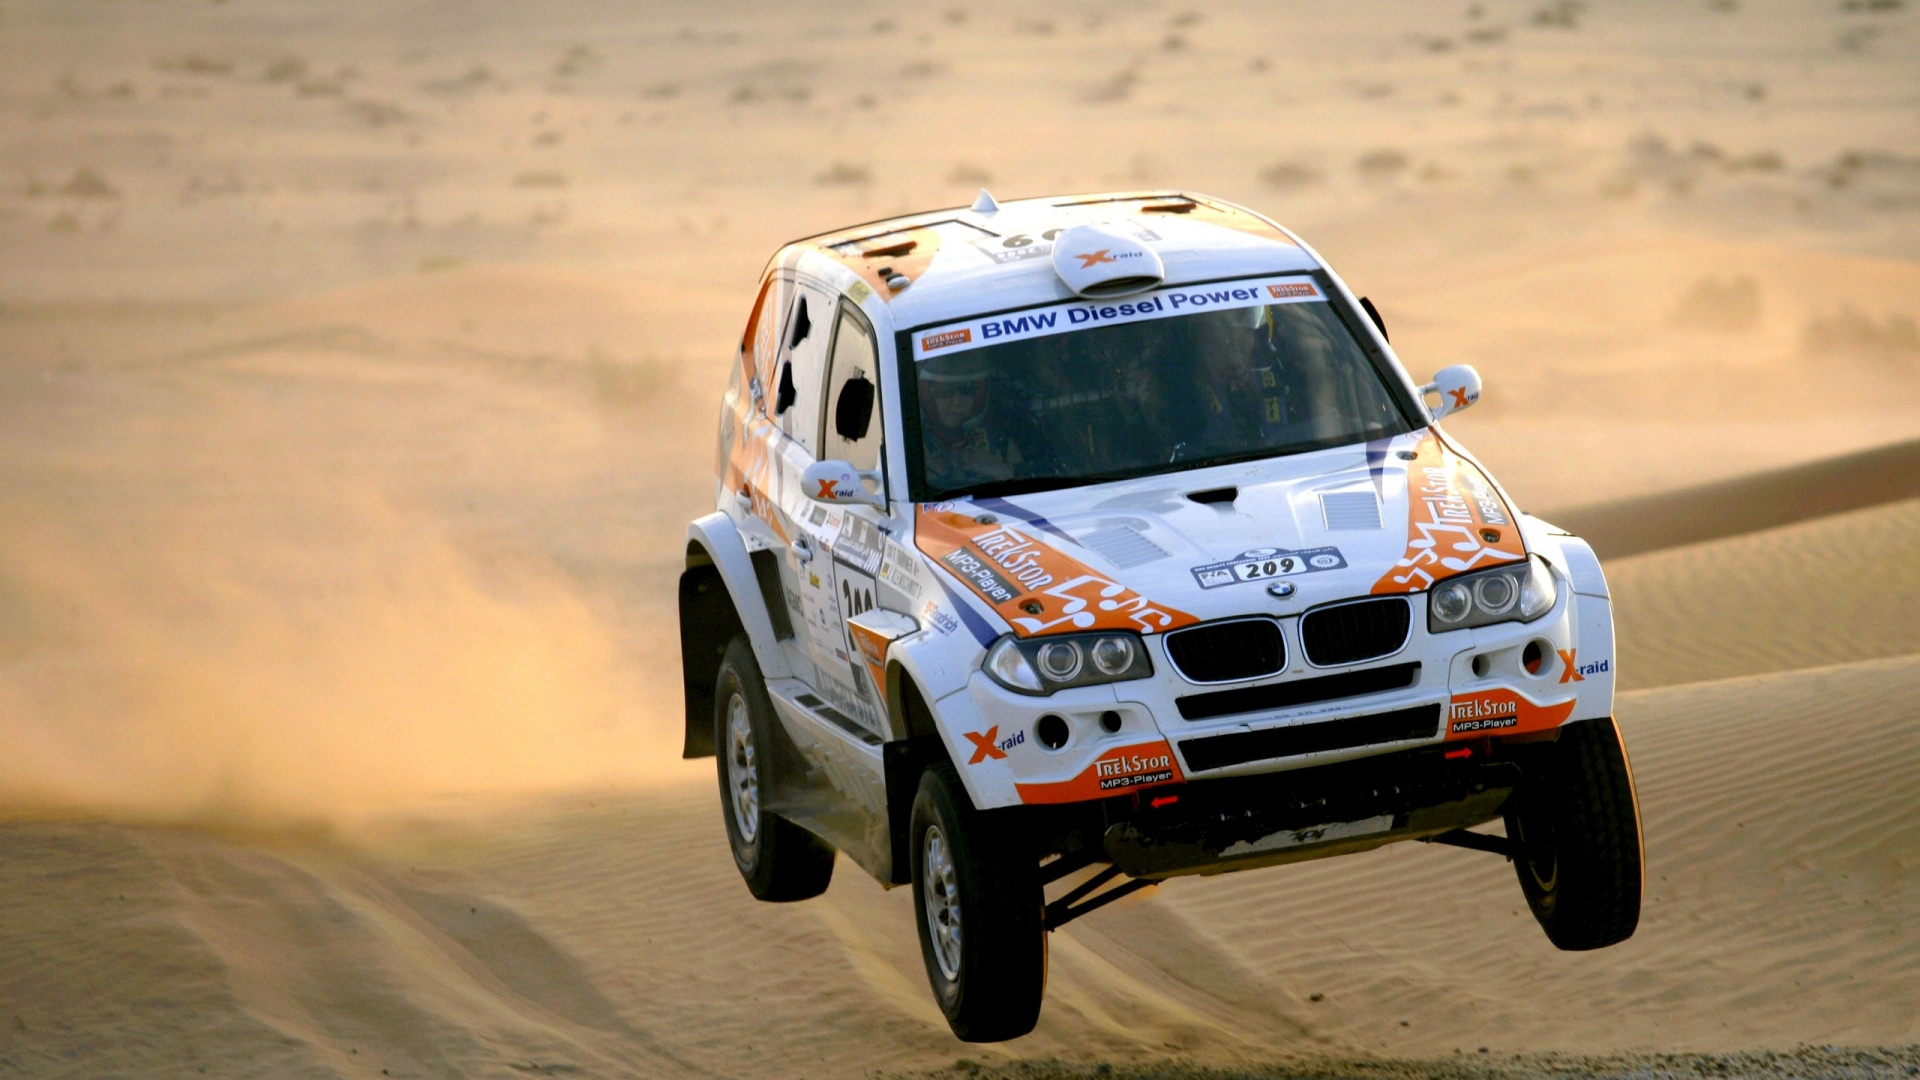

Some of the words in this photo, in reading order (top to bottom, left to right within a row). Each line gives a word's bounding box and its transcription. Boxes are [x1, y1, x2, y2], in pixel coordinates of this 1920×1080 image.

[980, 312, 1057, 340] BMW
[1066, 296, 1163, 324] Diesel
[1168, 286, 1259, 309] Power
[945, 549, 1012, 601] MP3-Player
[1246, 558, 1295, 579] 209
[1557, 648, 1609, 684] X-raid
[1453, 717, 1517, 732] MP3-Player
[962, 725, 1025, 766] X-raid
[1100, 772, 1172, 789] MP3-Player
